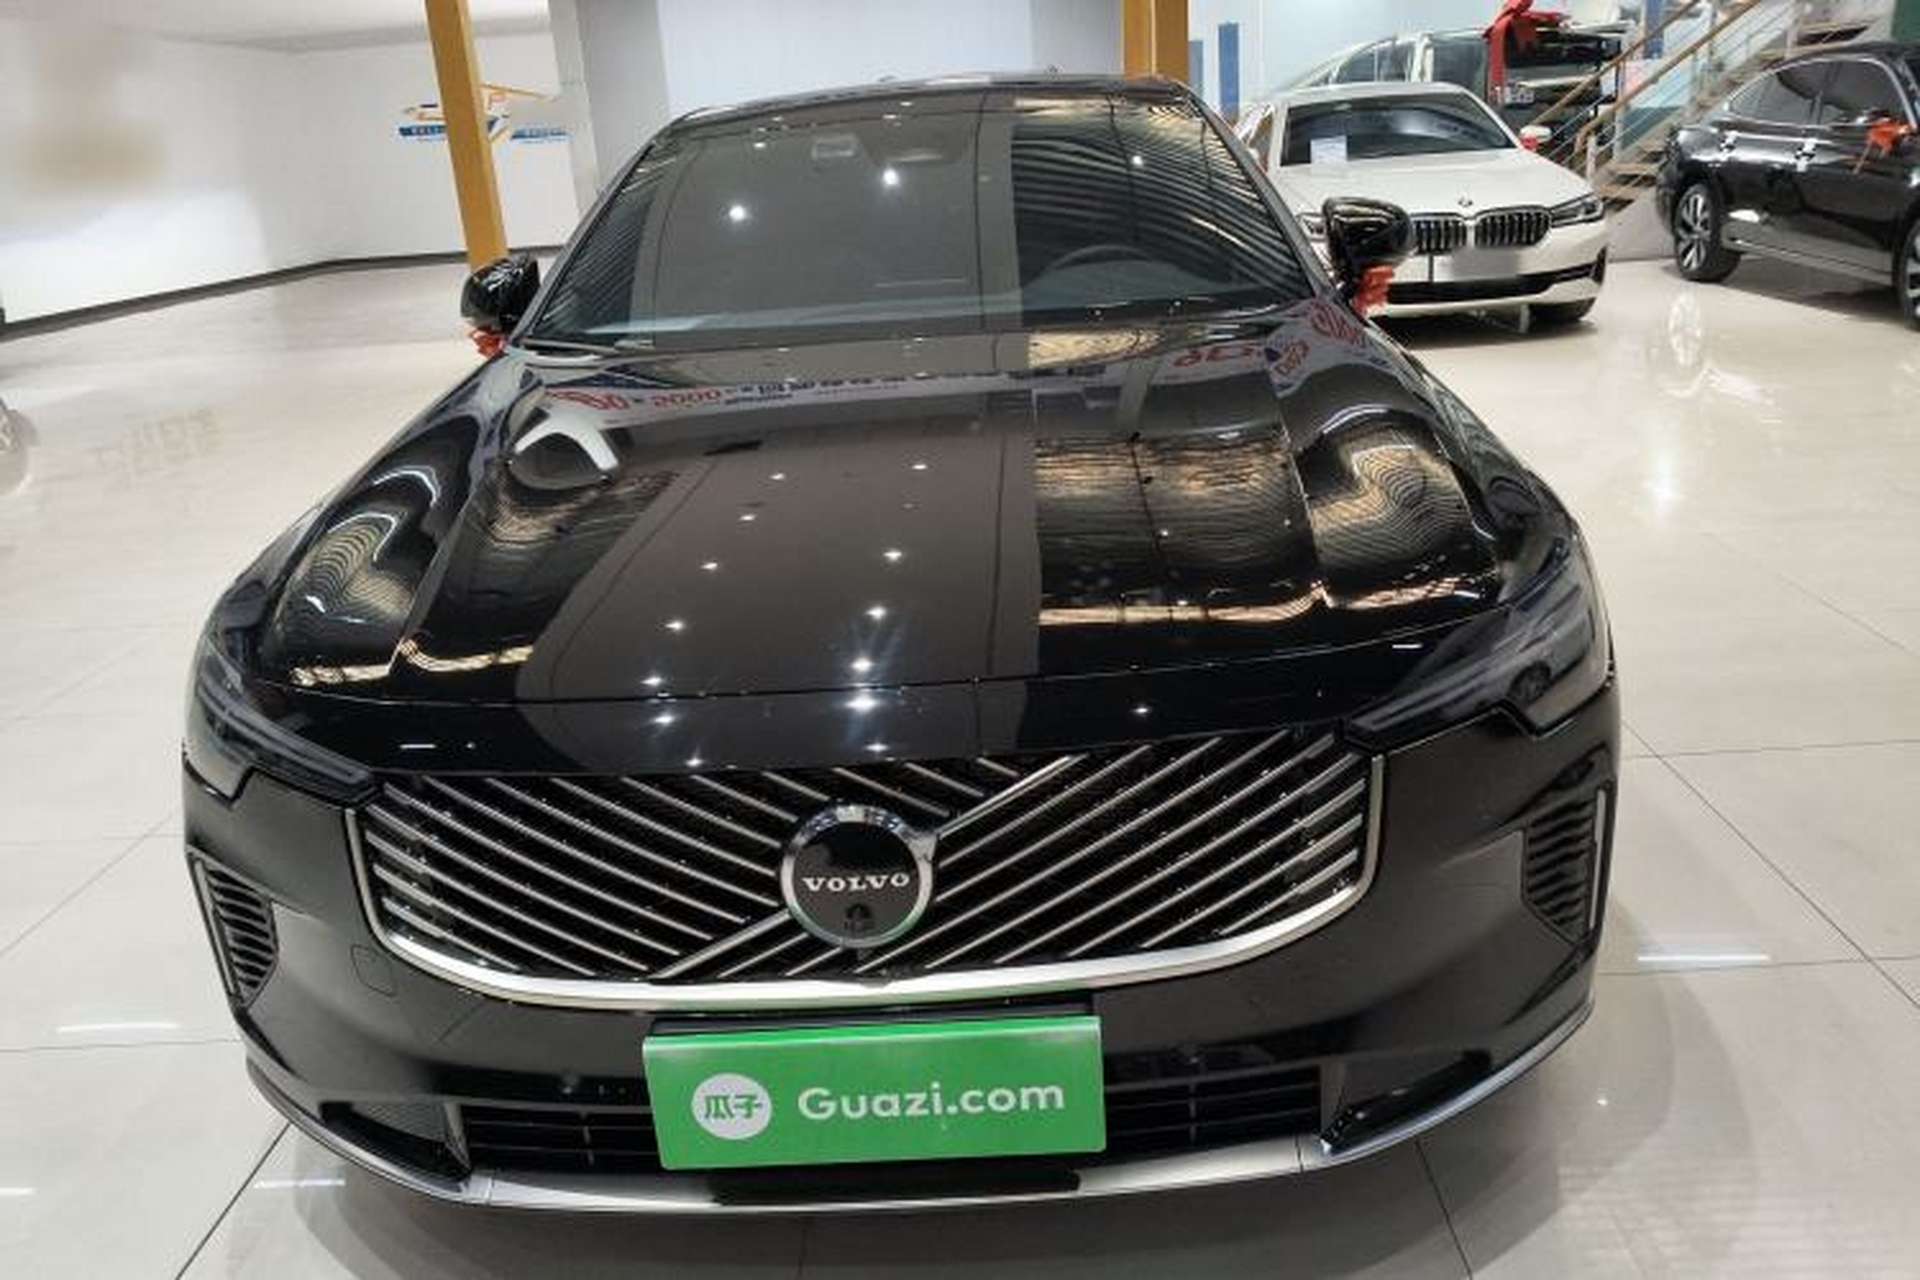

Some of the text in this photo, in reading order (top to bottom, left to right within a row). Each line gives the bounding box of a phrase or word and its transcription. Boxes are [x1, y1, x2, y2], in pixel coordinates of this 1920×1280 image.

[801, 873, 910, 892] VOLVO
[704, 1094, 763, 1119] 瓜子
[798, 1081, 1065, 1120] Guazi.com
